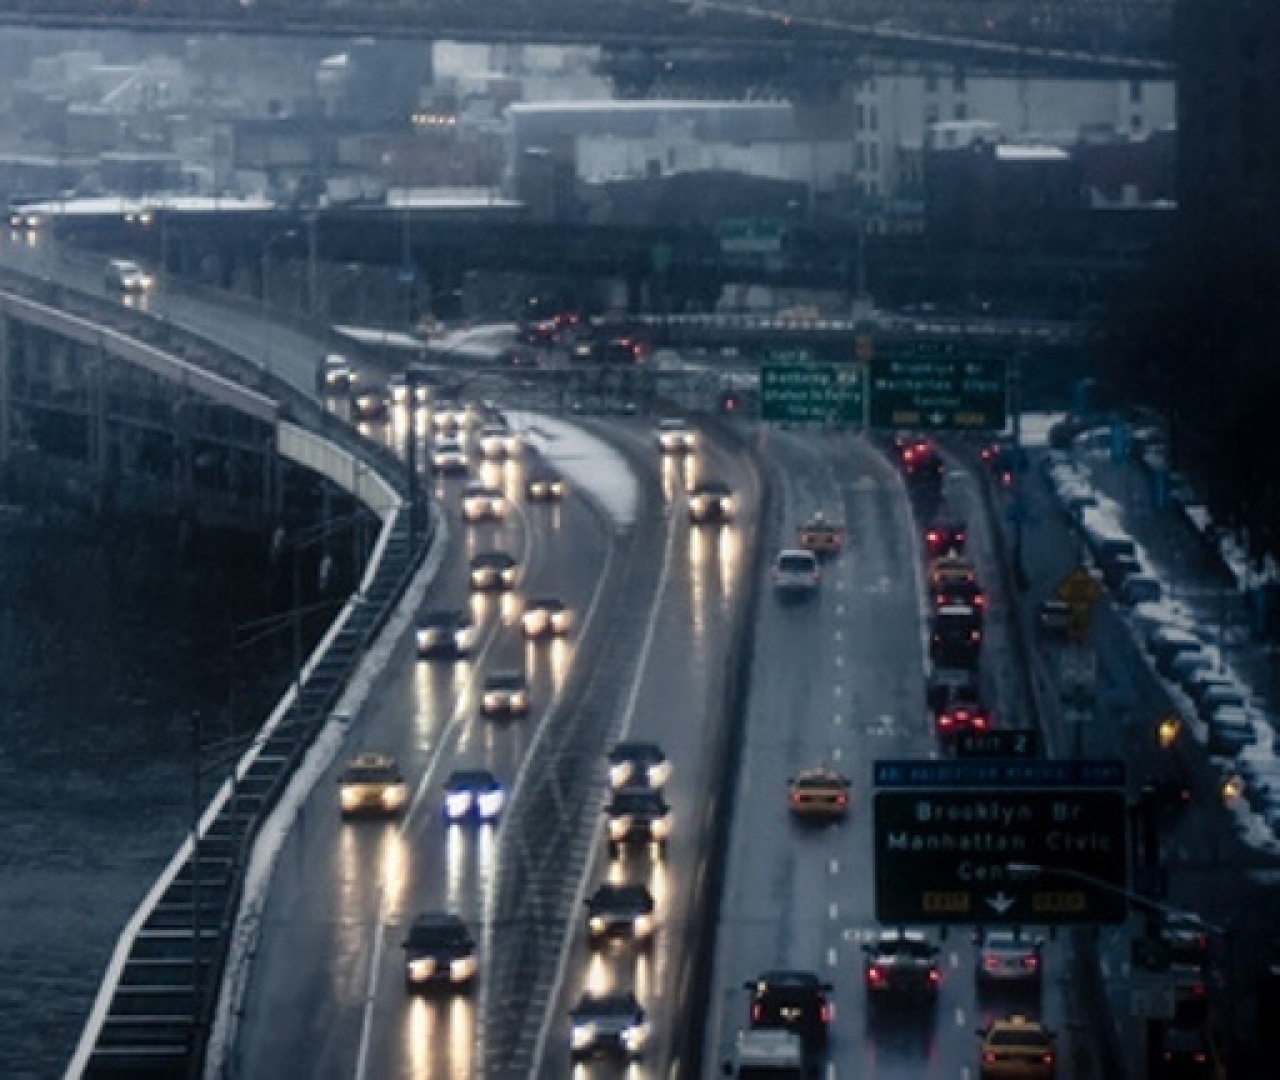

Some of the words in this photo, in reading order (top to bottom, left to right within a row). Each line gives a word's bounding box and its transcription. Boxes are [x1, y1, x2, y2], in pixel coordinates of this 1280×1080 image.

[915, 801, 1034, 826] Brooklyn
[1052, 801, 1081, 821] Br
[887, 832, 1026, 851] Manhattan
[1046, 832, 1112, 851] Civic
